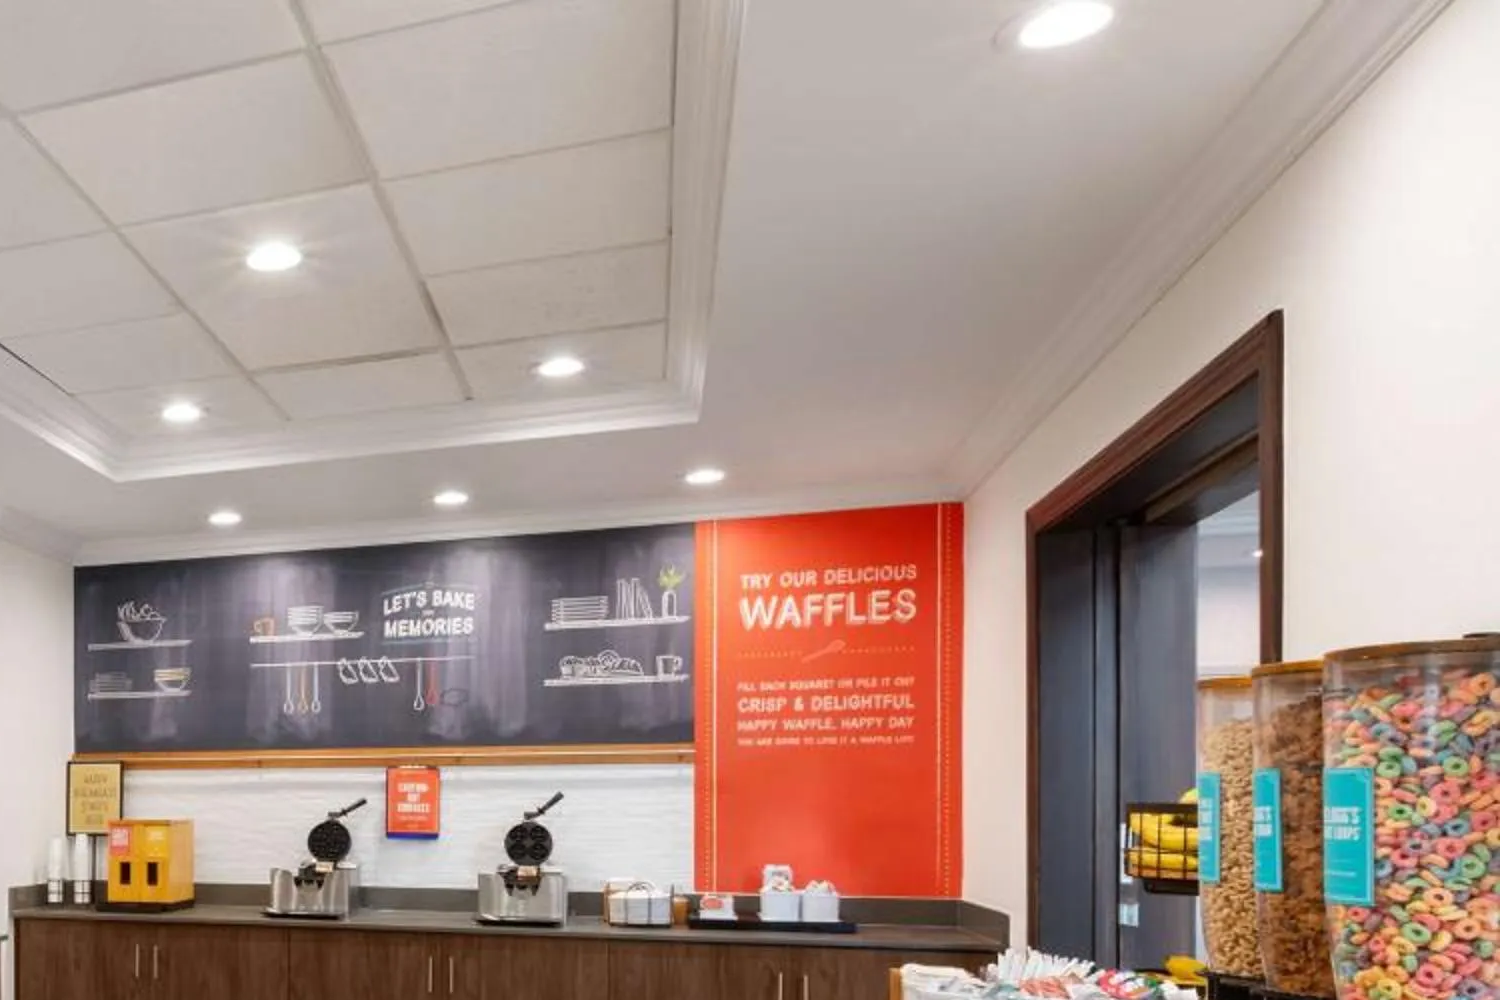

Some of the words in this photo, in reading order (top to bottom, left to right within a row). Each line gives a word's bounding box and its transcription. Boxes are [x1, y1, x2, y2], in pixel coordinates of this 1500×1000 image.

[739, 573, 773, 590] TRY
[779, 570, 817, 588] OUR
[823, 563, 917, 585] DELICIOUS
[383, 591, 427, 616] LET'S
[432, 590, 475, 611] BAKE
[739, 588, 917, 631] WAFFLES
[384, 616, 474, 638] MEMORIES
[737, 696, 787, 713] CRISP
[794, 695, 805, 712] &
[811, 693, 915, 713] DELIGHTFUL
[737, 719, 777, 732] HAPPY
[841, 716, 884, 730] HAPPY
[888, 715, 915, 730] DAY
